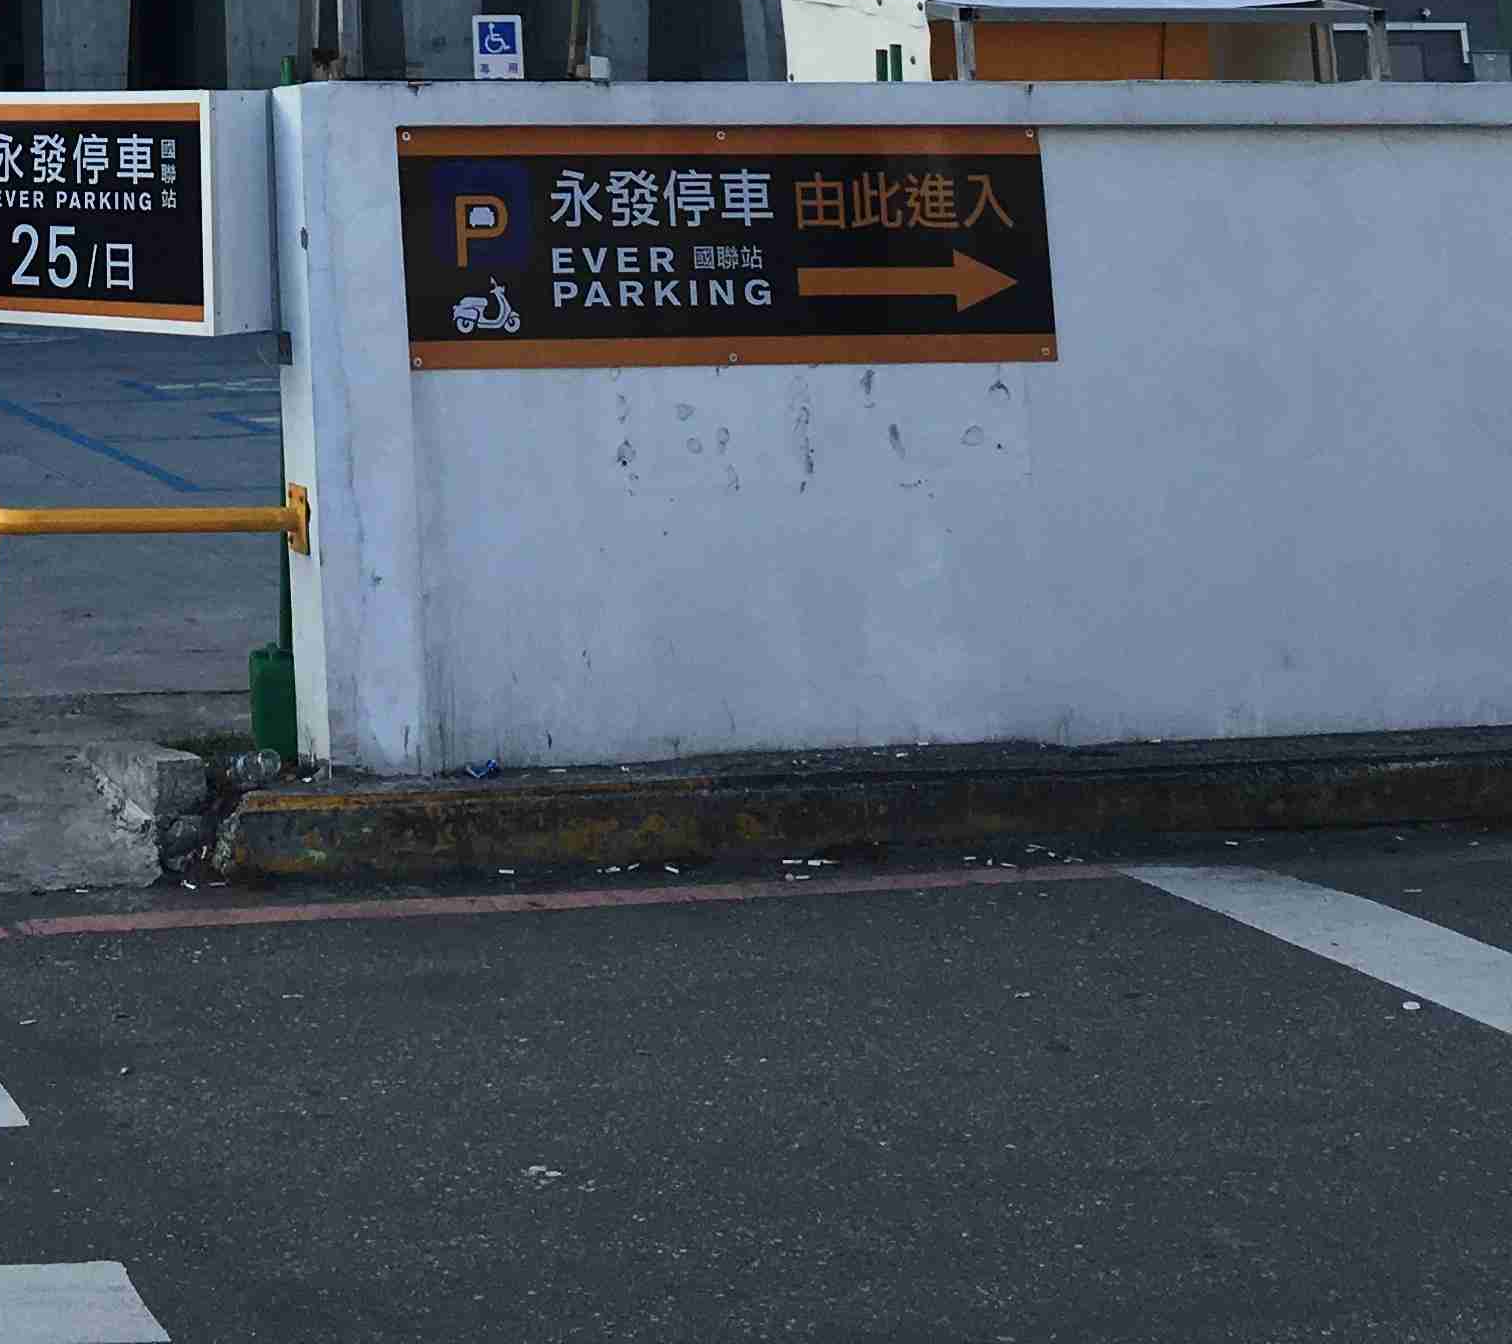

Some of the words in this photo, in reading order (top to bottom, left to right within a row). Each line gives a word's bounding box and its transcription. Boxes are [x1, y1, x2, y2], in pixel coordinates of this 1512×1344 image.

[160, 138, 178, 210] 國聯站
[55, 190, 153, 212] PARKING
[549, 169, 775, 229] 永發停車
[793, 172, 1017, 231] 由此進入
[551, 246, 676, 275] EVER
[692, 245, 764, 271] 國聯站
[552, 278, 773, 309] PARKING
